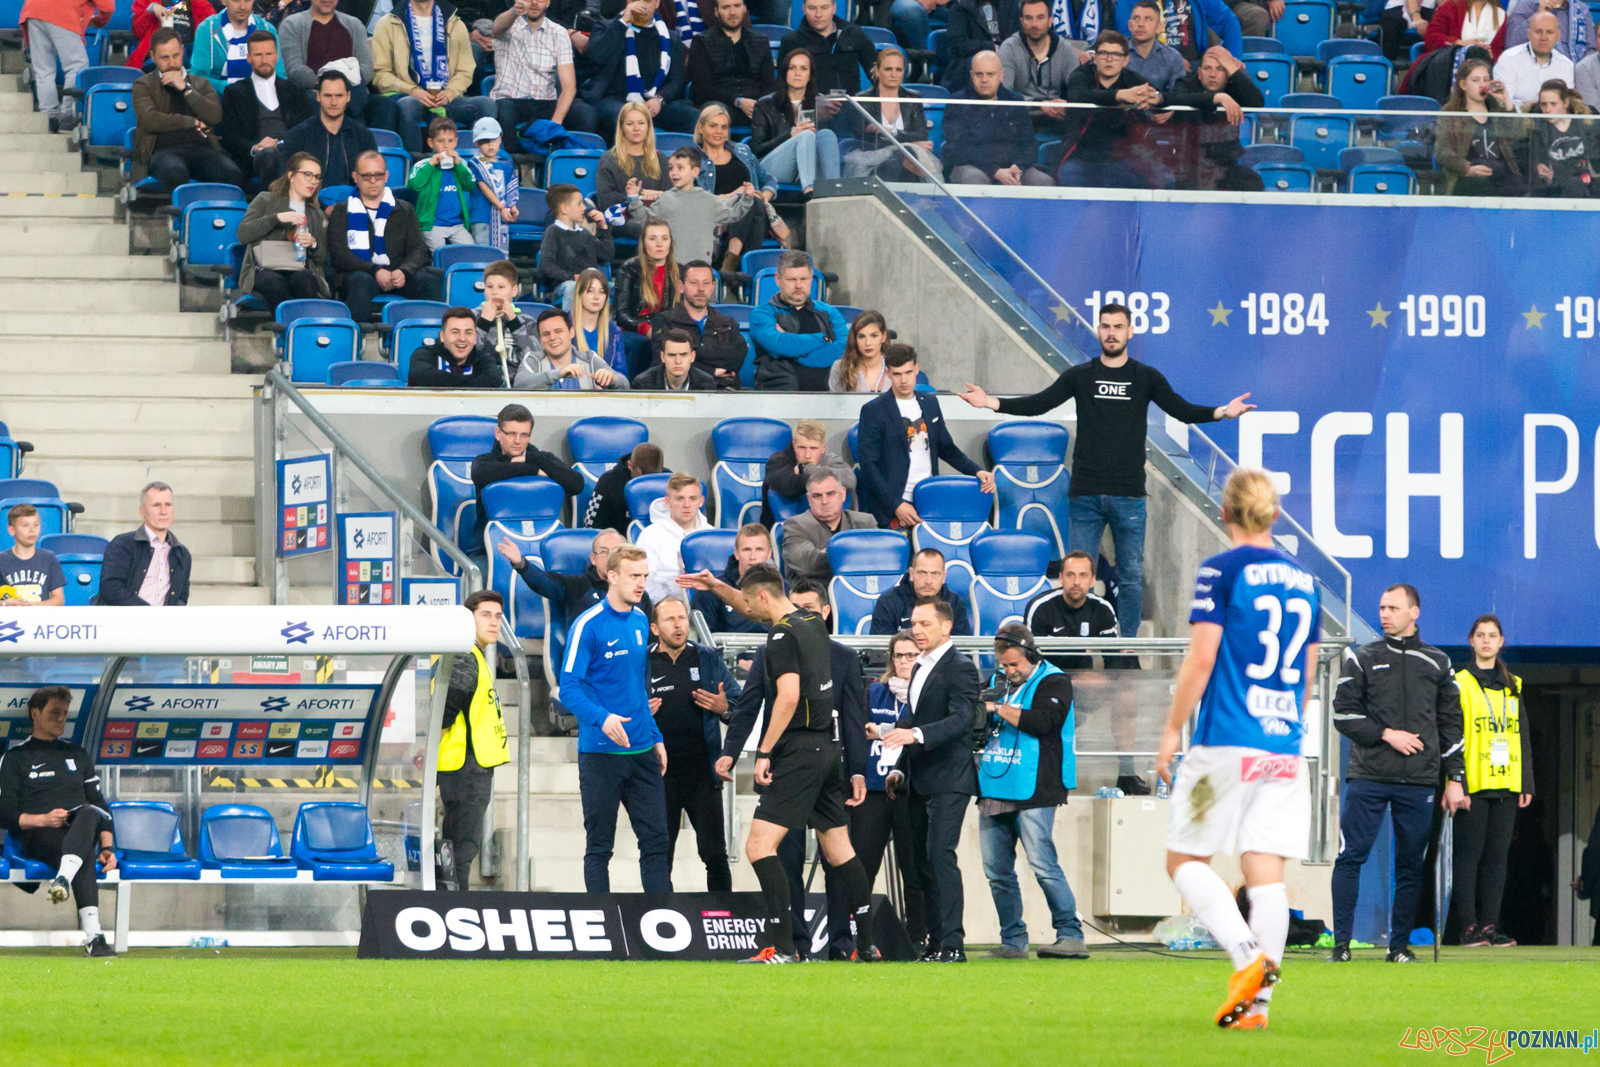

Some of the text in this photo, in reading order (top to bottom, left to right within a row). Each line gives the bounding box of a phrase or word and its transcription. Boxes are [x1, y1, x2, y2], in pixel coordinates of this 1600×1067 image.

[1240, 292, 1330, 336] 1984
[1399, 294, 1486, 338] 1990
[1555, 295, 1600, 339] 19
[1098, 384, 1127, 396] ONE
[1165, 411, 1600, 560] ECH P
[366, 531, 388, 546] AFORTI
[6, 570, 47, 585] HARLEM
[33, 624, 97, 640] AFORTI
[322, 625, 387, 641] AFORTI
[1245, 594, 1313, 685] 32
[161, 698, 219, 709] AFORTI
[296, 699, 355, 710] AFORTI
[395, 906, 613, 952] OSHEE
[702, 918, 766, 934] ENERGY
[706, 934, 759, 950] DRINK
